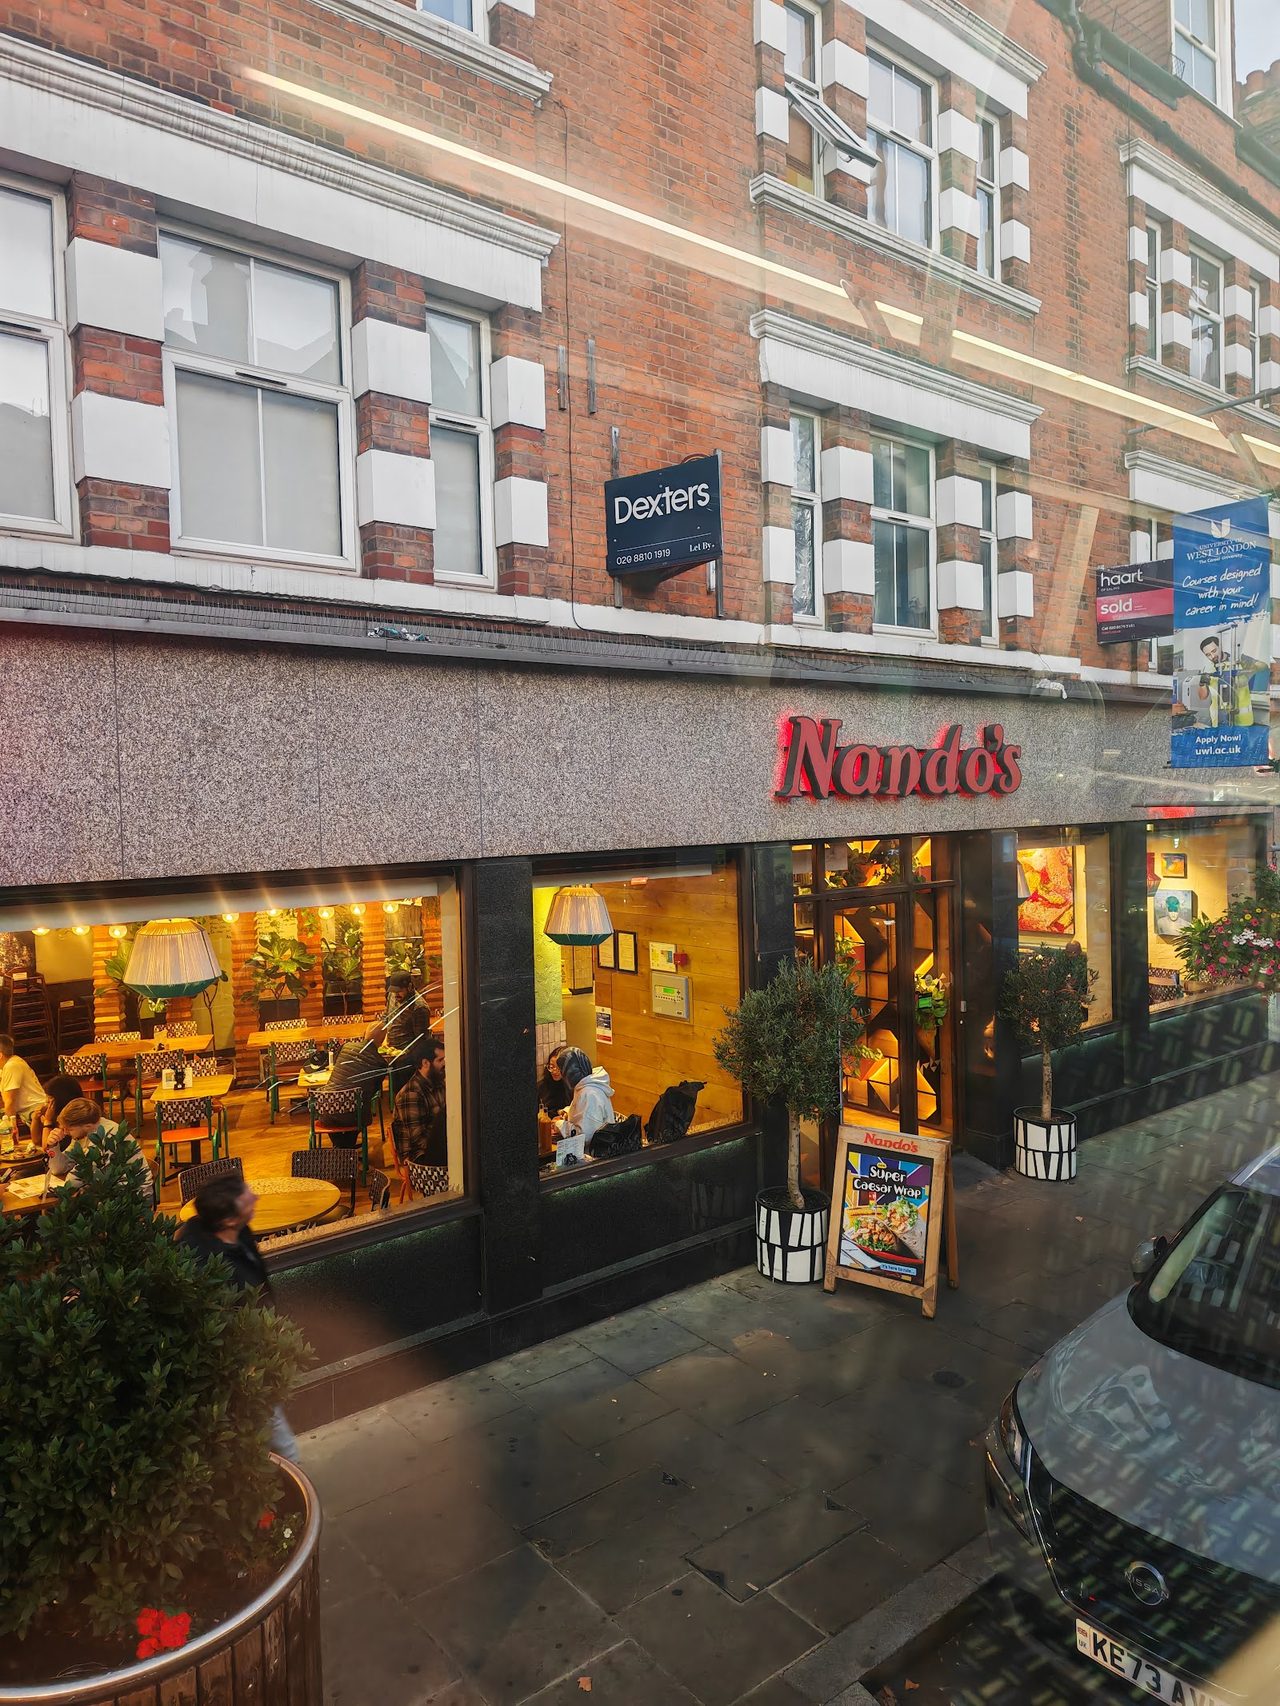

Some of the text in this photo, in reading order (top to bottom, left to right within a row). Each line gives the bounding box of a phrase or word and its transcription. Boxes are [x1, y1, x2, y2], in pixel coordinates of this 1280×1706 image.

[614, 483, 710, 525] Dexters
[689, 543, 701, 552] Let
[1186, 540, 1257, 561] WEST LONDON
[1199, 539, 1233, 550] UNIVERSITY
[616, 548, 671, 566] 020 8810 1919
[1101, 568, 1144, 587] haart
[1182, 562, 1263, 588] Courses designed
[1198, 585, 1244, 600] with your
[1101, 598, 1133, 614] sold
[1185, 592, 1259, 616] career in mind!
[1195, 734, 1242, 744] Apply Now!
[775, 716, 1022, 800] Nando's
[1195, 744, 1242, 755] uwl.ac.uk
[863, 1132, 919, 1153] Nando's
[869, 1165, 906, 1183] Super
[853, 1178, 921, 1199] Caesar Wrap
[1124, 1570, 1169, 1600] NISSAN
[1092, 1631, 1161, 1693] KE73
